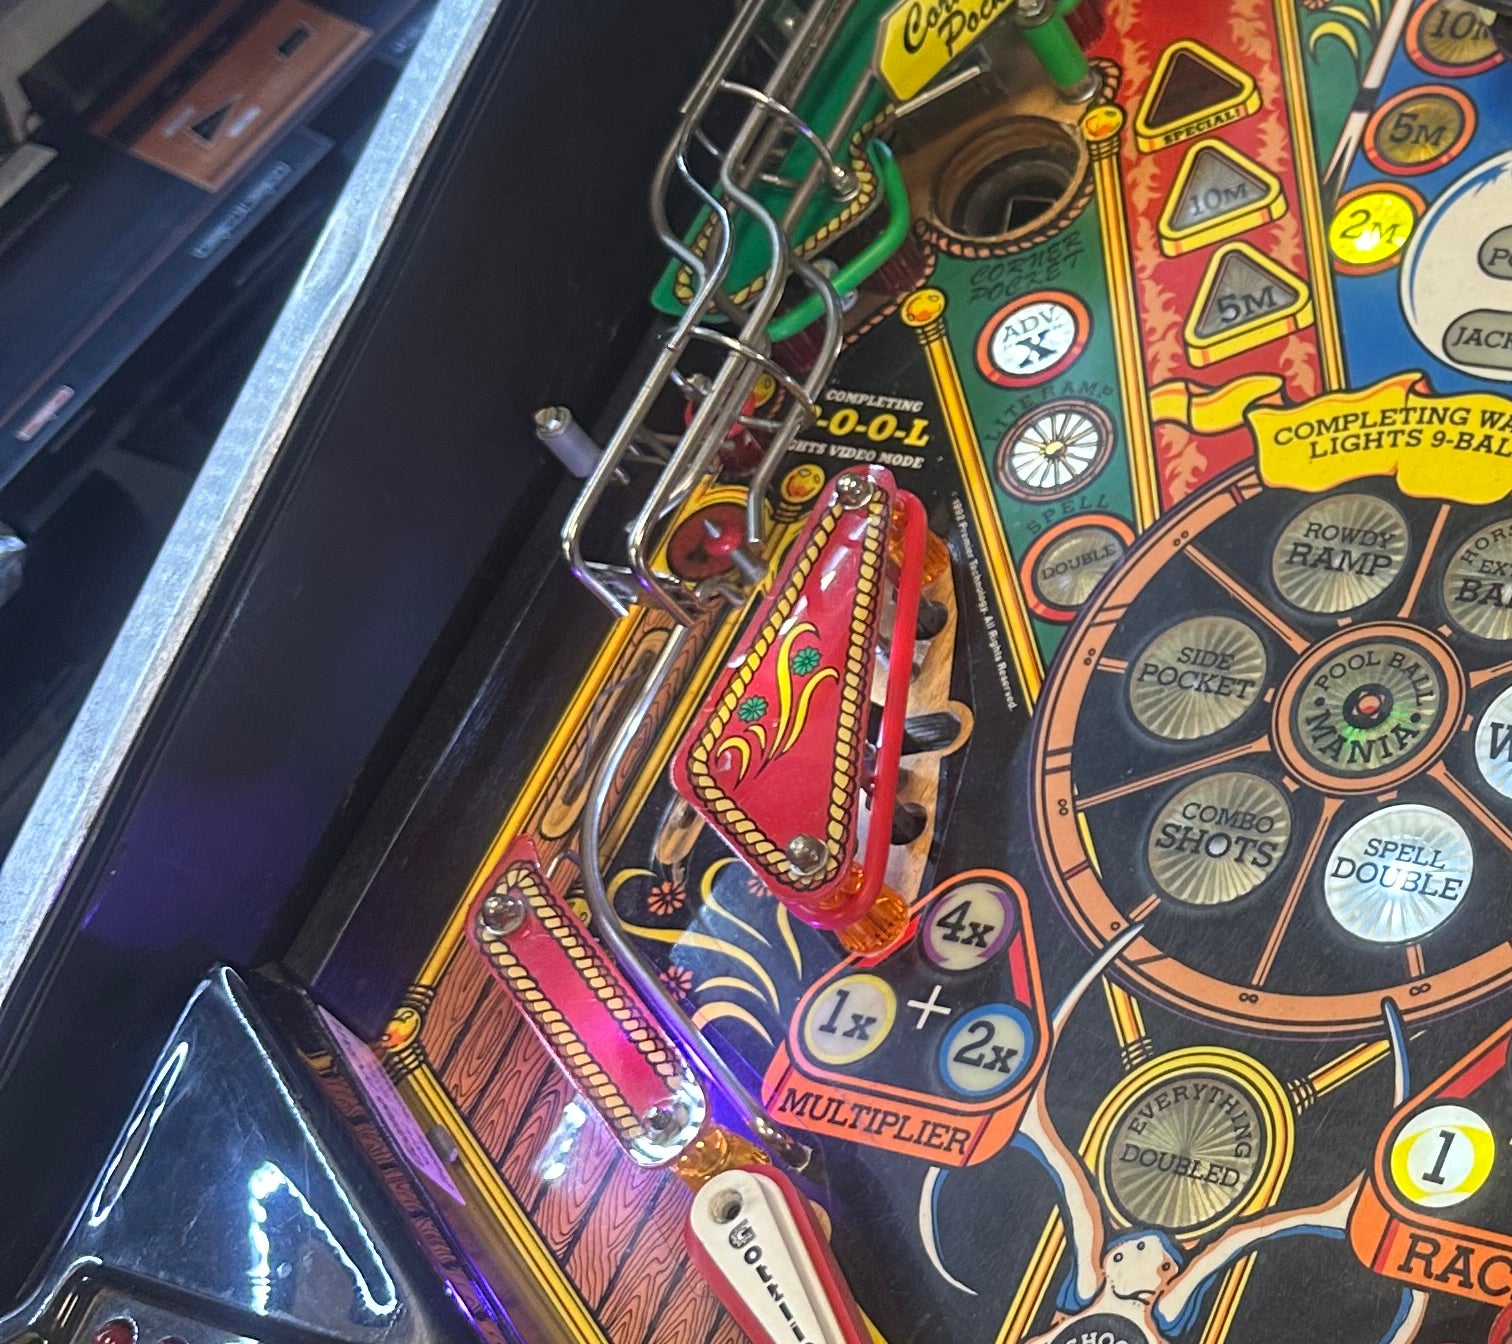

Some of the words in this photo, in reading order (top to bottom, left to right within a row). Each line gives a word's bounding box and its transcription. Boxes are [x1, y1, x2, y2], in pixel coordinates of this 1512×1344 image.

[1162, 107, 1243, 146] SPECIAL!
[1388, 111, 1448, 147] 5M
[1188, 182, 1249, 218] 10M
[1340, 208, 1401, 245] 2M
[1216, 285, 1280, 325] 5M
[825, 389, 925, 413] COMPLETING
[1273, 406, 1475, 448] COMPLETING
[828, 444, 878, 462] VIDEO
[878, 452, 926, 470] MODE
[1308, 428, 1423, 465] LIGHTS
[1303, 522, 1396, 550] ROWDY
[1041, 542, 1118, 581] DOUBLE
[1285, 542, 1393, 578] RAMP
[1176, 646, 1237, 671] SIDE
[1136, 662, 1256, 700] POCKET
[1314, 650, 1381, 692] POOL
[1387, 651, 1434, 706] BALL
[1305, 708, 1422, 765] MANIA
[1181, 802, 1275, 835] COMBO
[1154, 822, 1280, 869] SHOTS
[1363, 837, 1446, 870] SPELL
[1330, 856, 1465, 902] DOUBLE
[777, 1086, 973, 1156] MULTIPLIER
[1127, 1082, 1254, 1160] EVERYTHING
[1118, 1142, 1241, 1190] DOUBLED
[1421, 1128, 1457, 1186] 1
